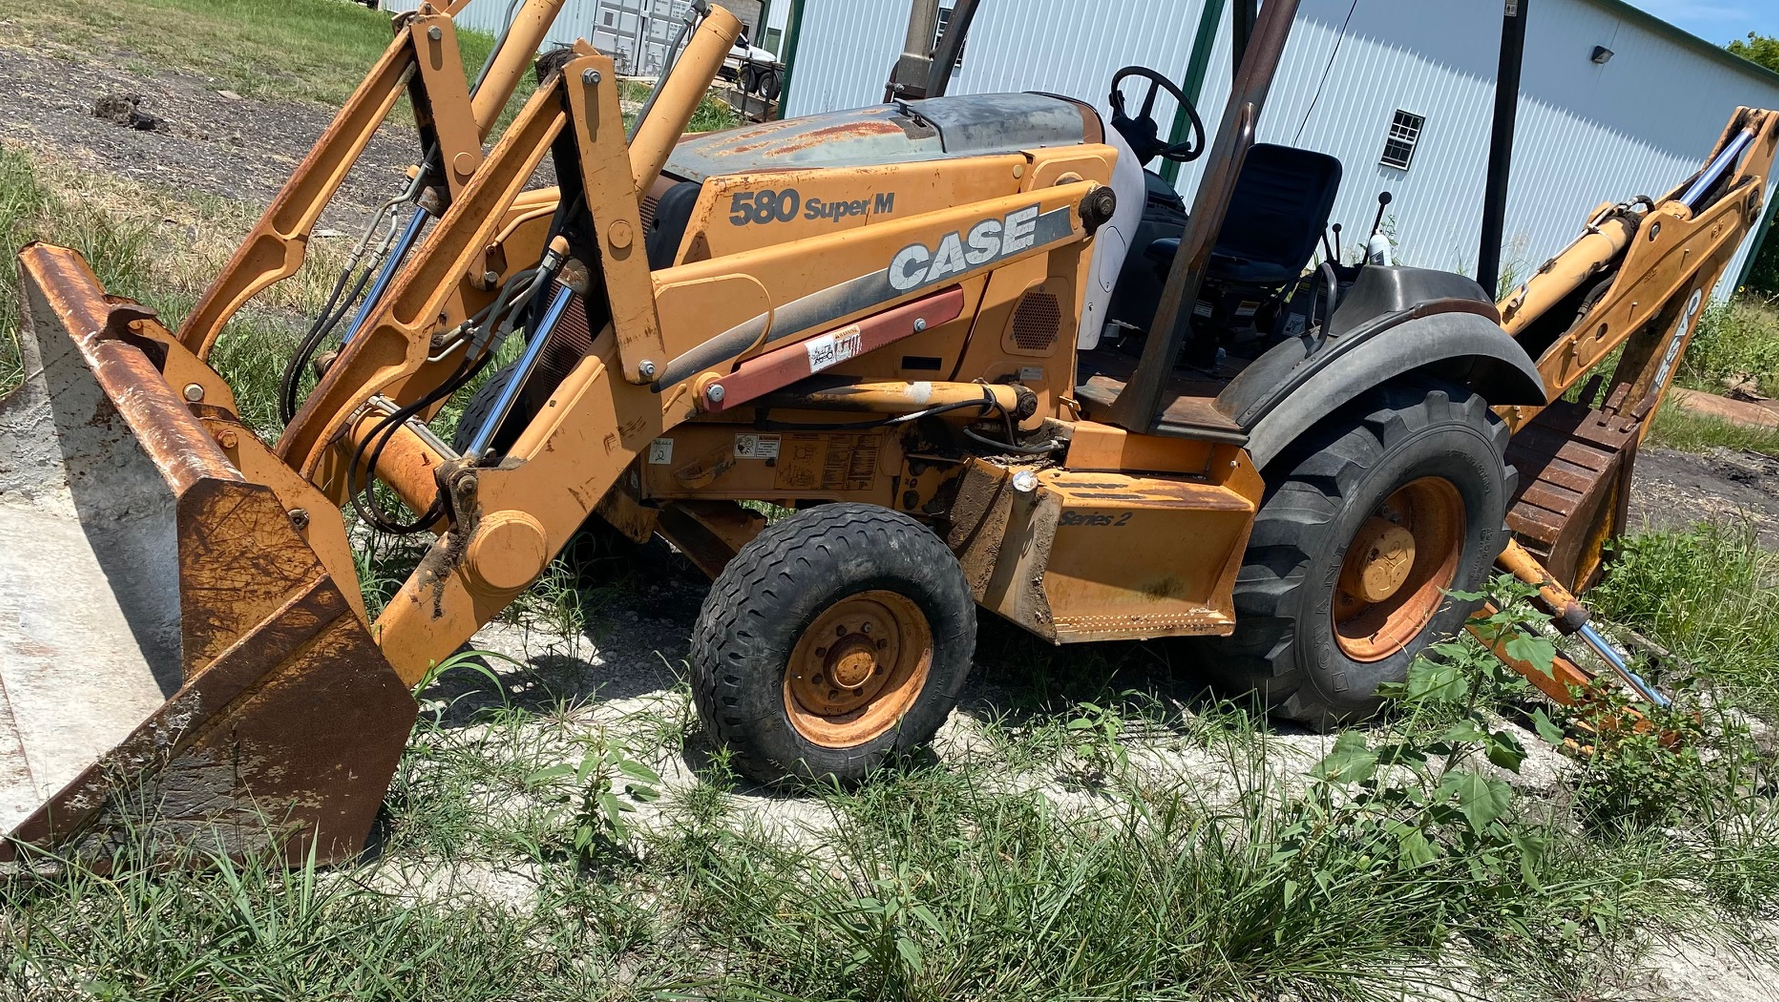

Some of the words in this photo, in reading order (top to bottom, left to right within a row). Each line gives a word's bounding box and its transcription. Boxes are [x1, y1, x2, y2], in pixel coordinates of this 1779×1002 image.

[729, 188, 800, 226] 580
[804, 197, 872, 223] Super
[873, 192, 895, 214] M
[888, 205, 1040, 291] CASE
[1655, 287, 1703, 389] CASE
[1058, 511, 1114, 526] Series
[1113, 511, 1133, 527] 2
